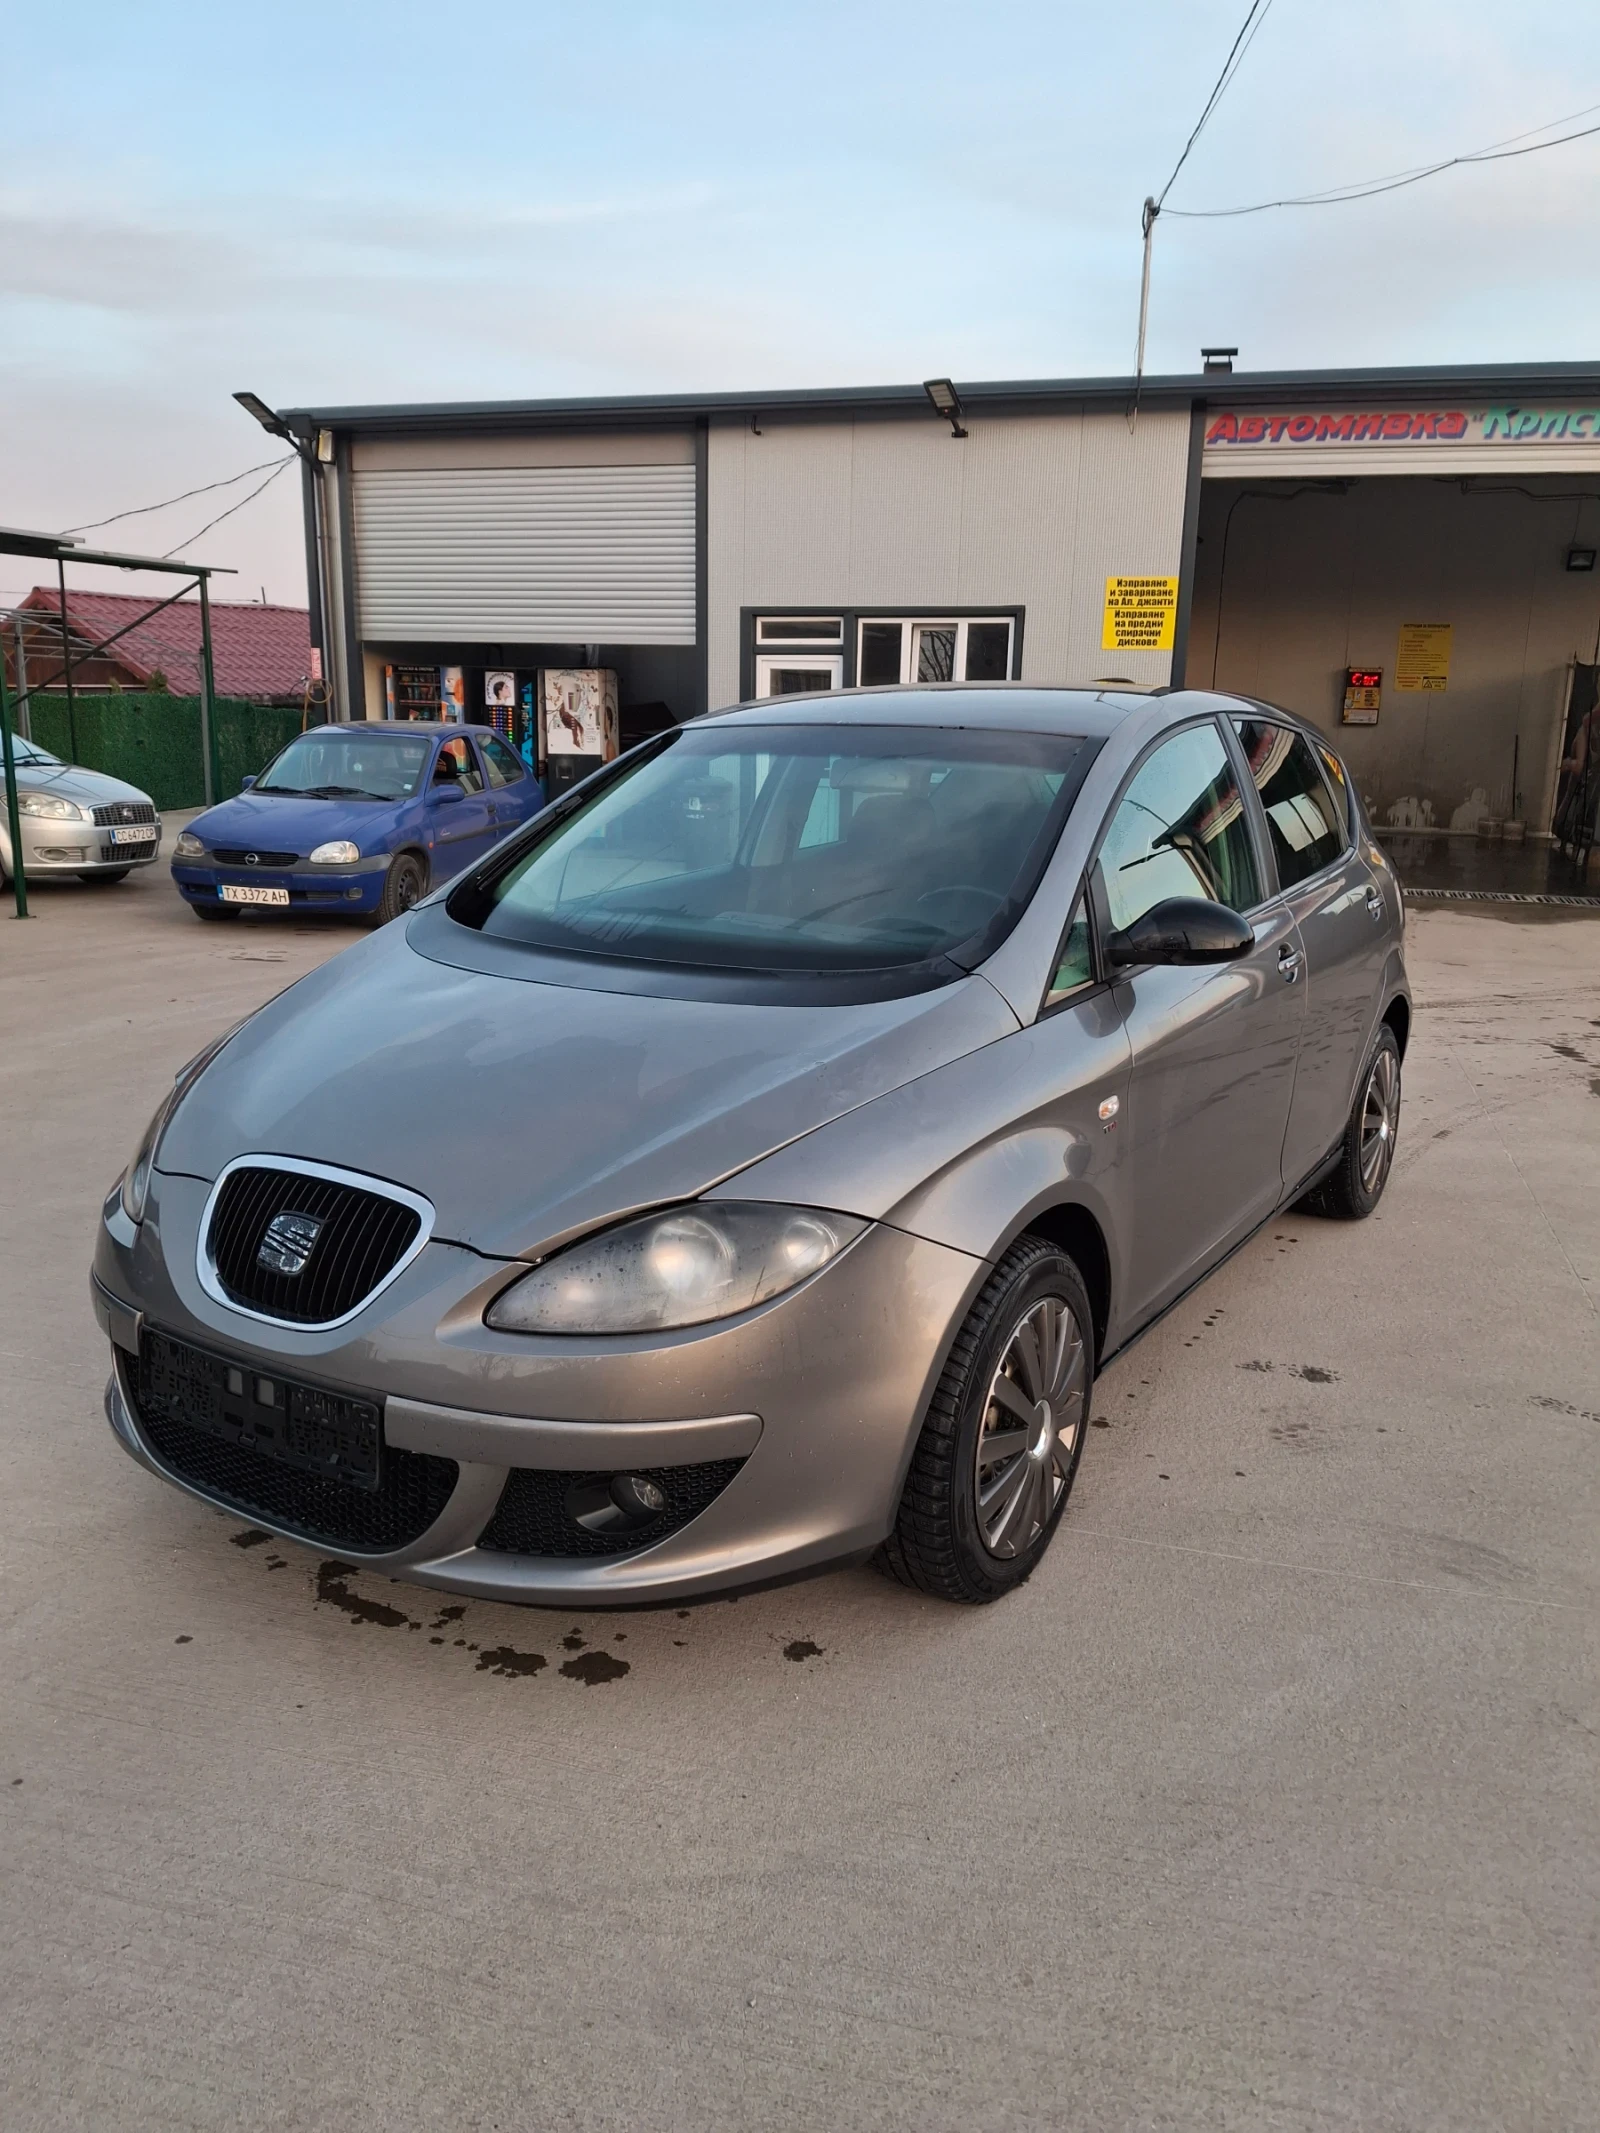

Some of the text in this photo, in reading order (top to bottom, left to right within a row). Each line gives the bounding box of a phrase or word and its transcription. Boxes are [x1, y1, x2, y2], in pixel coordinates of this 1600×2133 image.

[1206, 412, 1468, 444] Автомивка
[1117, 579, 1168, 588] Изправяне
[1110, 589, 1173, 597] и заваряване
[1121, 598, 1135, 606] Ал.
[1136, 599, 1174, 607] джанти
[1114, 610, 1165, 619] Изправяне
[1115, 629, 1161, 637] спирачни
[1117, 639, 1158, 647] дискове
[224, 887, 287, 903] TX 3372 AH
